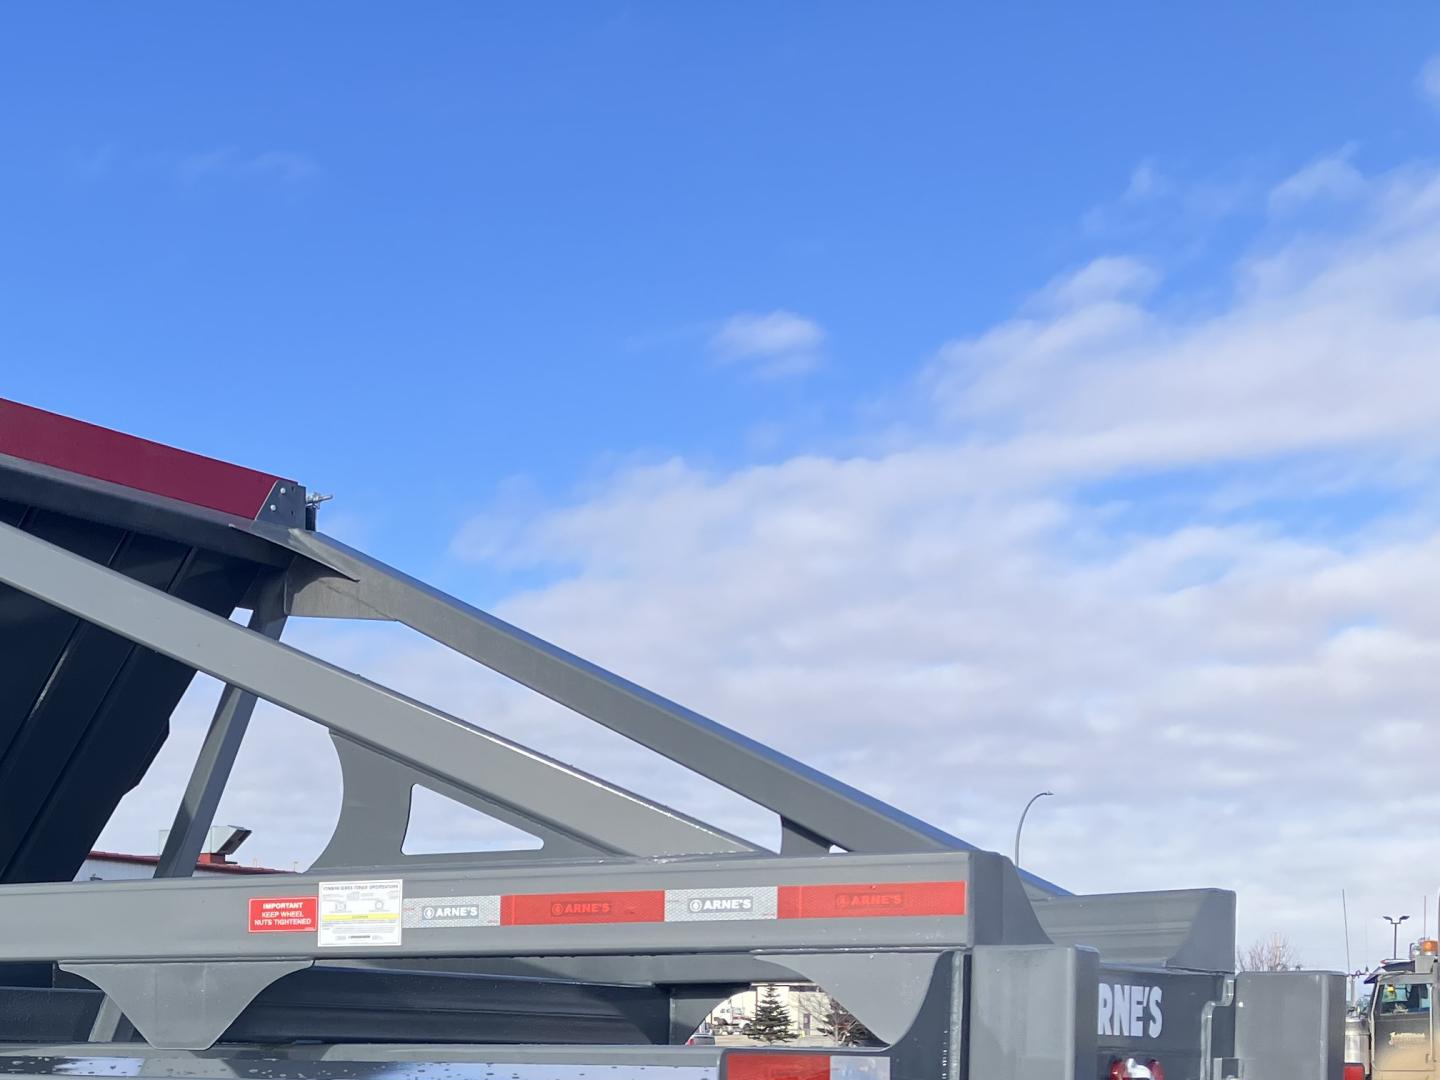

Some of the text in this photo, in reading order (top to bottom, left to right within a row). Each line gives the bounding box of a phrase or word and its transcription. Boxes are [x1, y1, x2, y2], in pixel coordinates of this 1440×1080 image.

[262, 902, 303, 910] IMPORTANT
[564, 902, 610, 914] ARNE'S
[703, 899, 751, 910] ARNE'S
[435, 906, 478, 918] ARNE'S
[273, 918, 312, 926] TIGHTENED
[1097, 982, 1163, 1039] RNE'S
